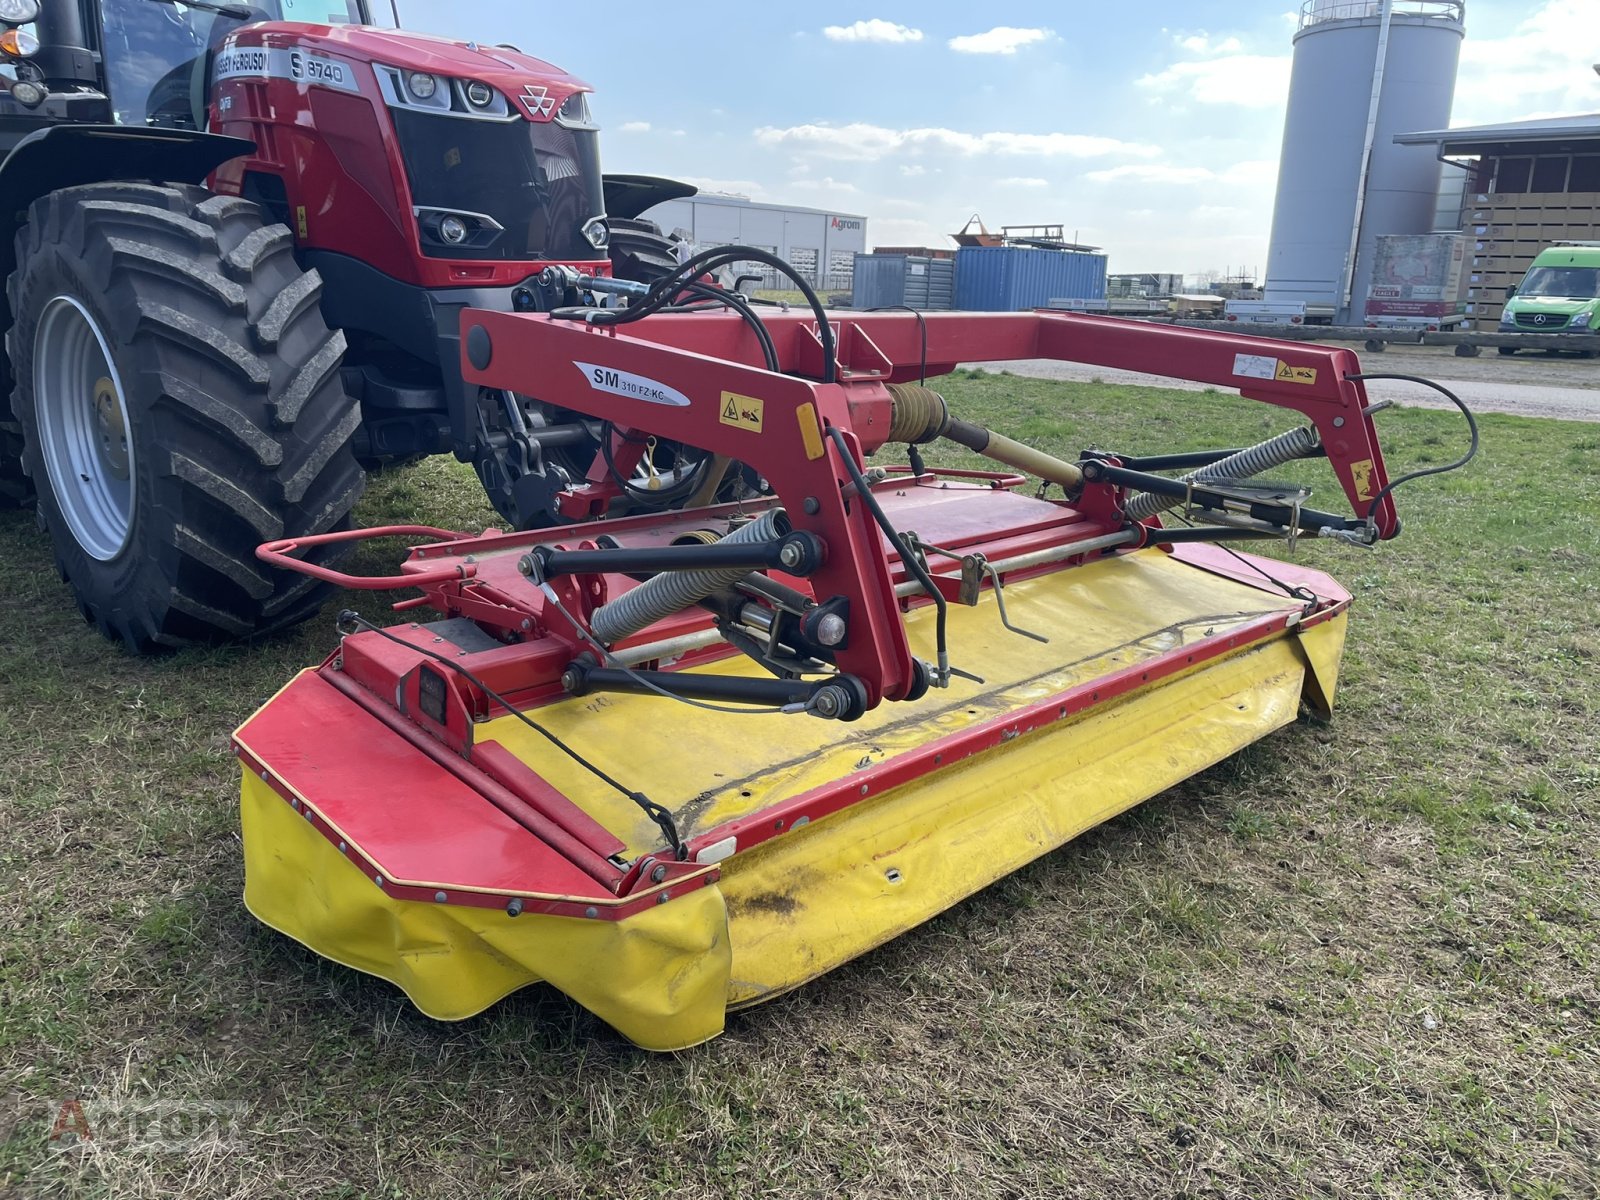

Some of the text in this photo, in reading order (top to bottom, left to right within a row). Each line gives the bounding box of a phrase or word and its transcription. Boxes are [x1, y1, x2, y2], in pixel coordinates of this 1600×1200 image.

[216, 52, 270, 75] SSEY FERGUSON
[290, 52, 344, 83] S 8740
[831, 216, 860, 231] Agrom
[593, 368, 619, 388] SM
[621, 381, 637, 393] 310
